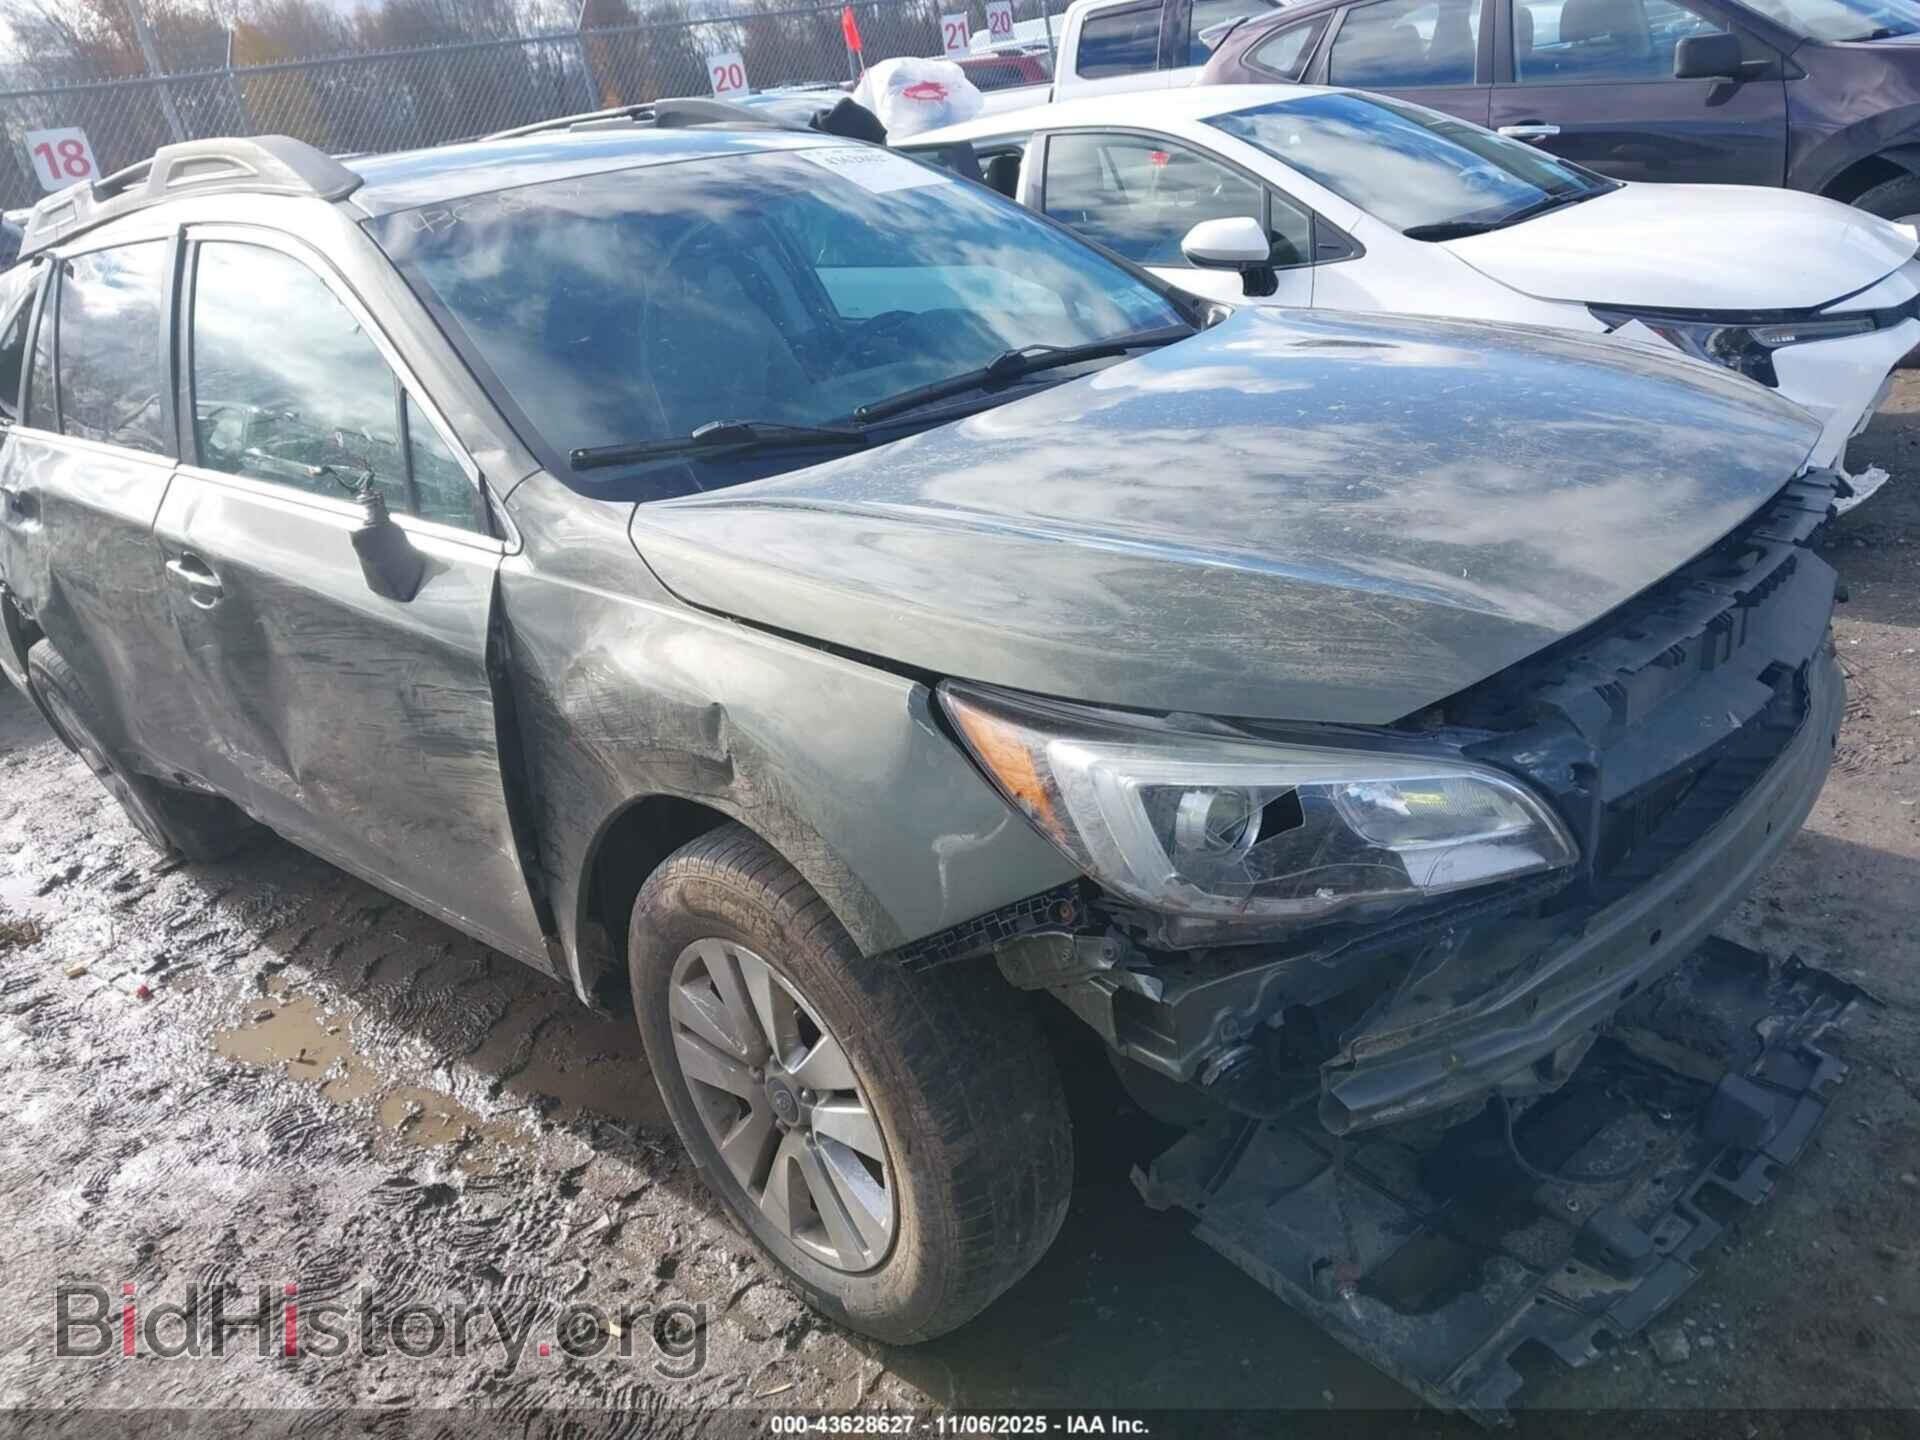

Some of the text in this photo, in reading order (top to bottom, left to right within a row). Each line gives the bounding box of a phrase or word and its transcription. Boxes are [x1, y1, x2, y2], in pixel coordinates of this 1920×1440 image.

[945, 21, 968, 50] 21
[991, 11, 1010, 34] 20
[713, 64, 743, 92] 20
[34, 140, 91, 179] 18
